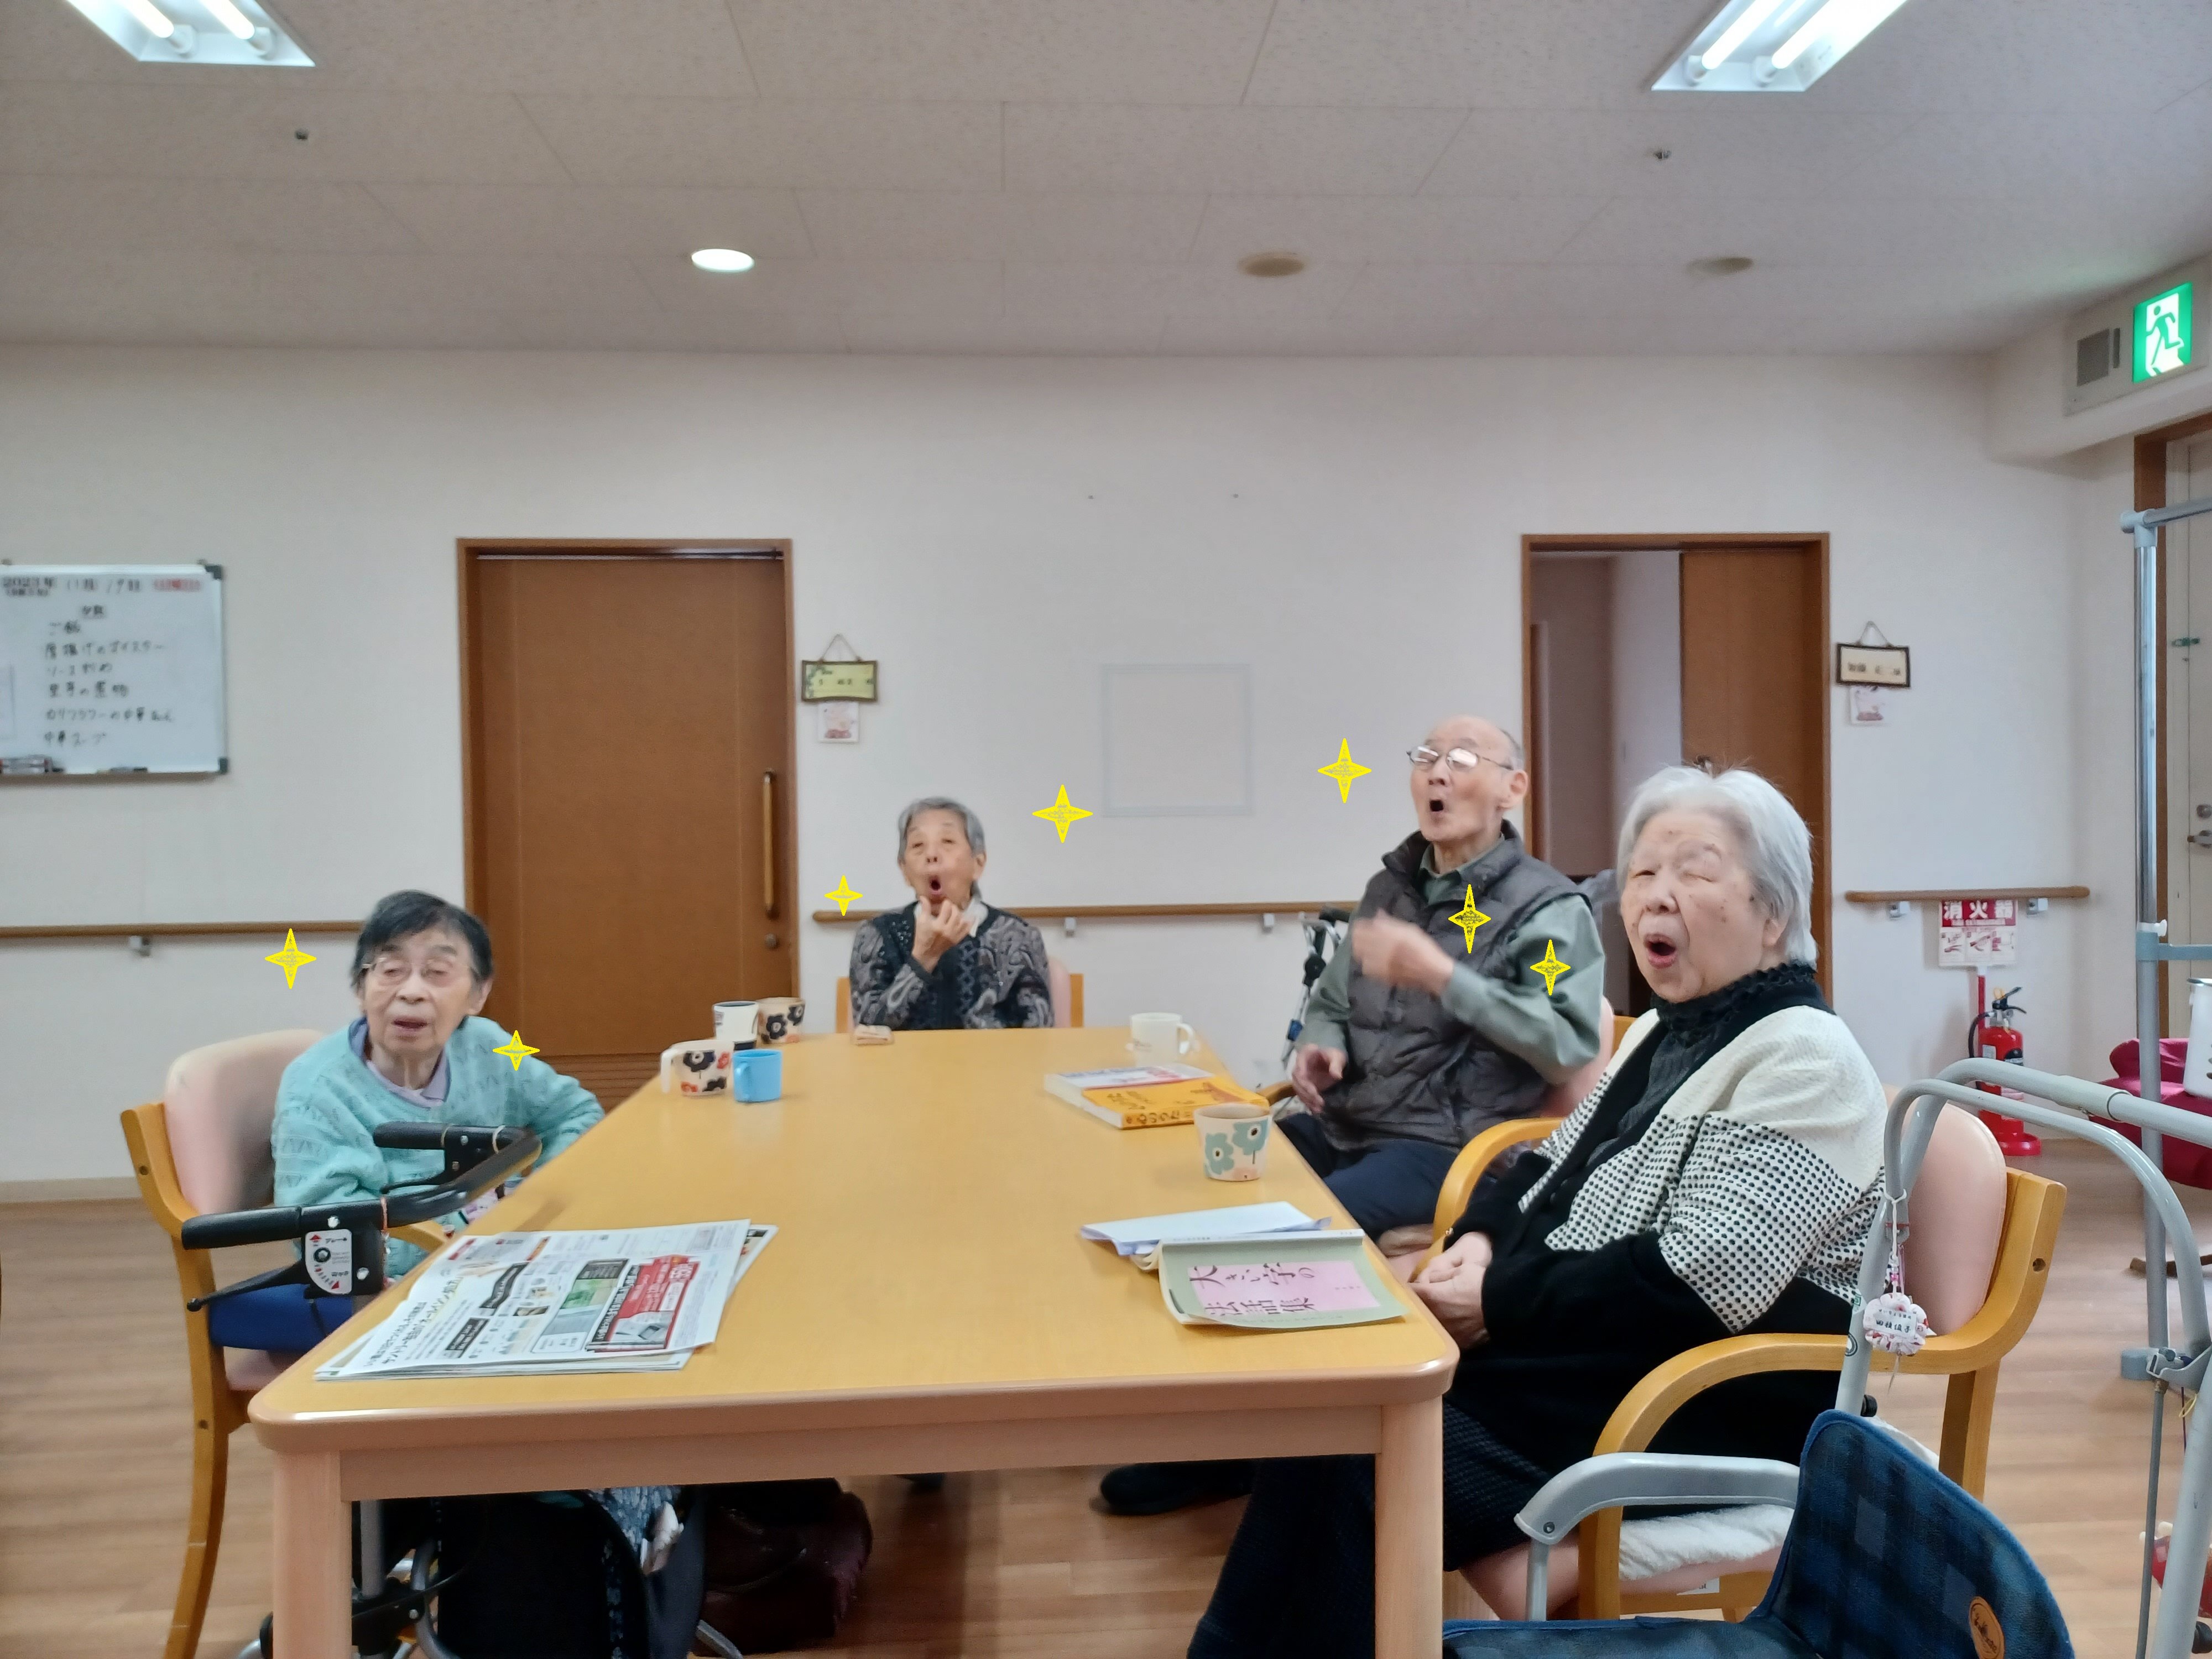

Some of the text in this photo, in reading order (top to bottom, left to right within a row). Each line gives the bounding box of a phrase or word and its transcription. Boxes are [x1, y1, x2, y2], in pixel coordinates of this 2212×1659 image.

[1943, 900, 2013, 920] 消火器
[1190, 1262, 1315, 1288] 大きい字の
[1205, 1297, 1319, 1316] 法話集
